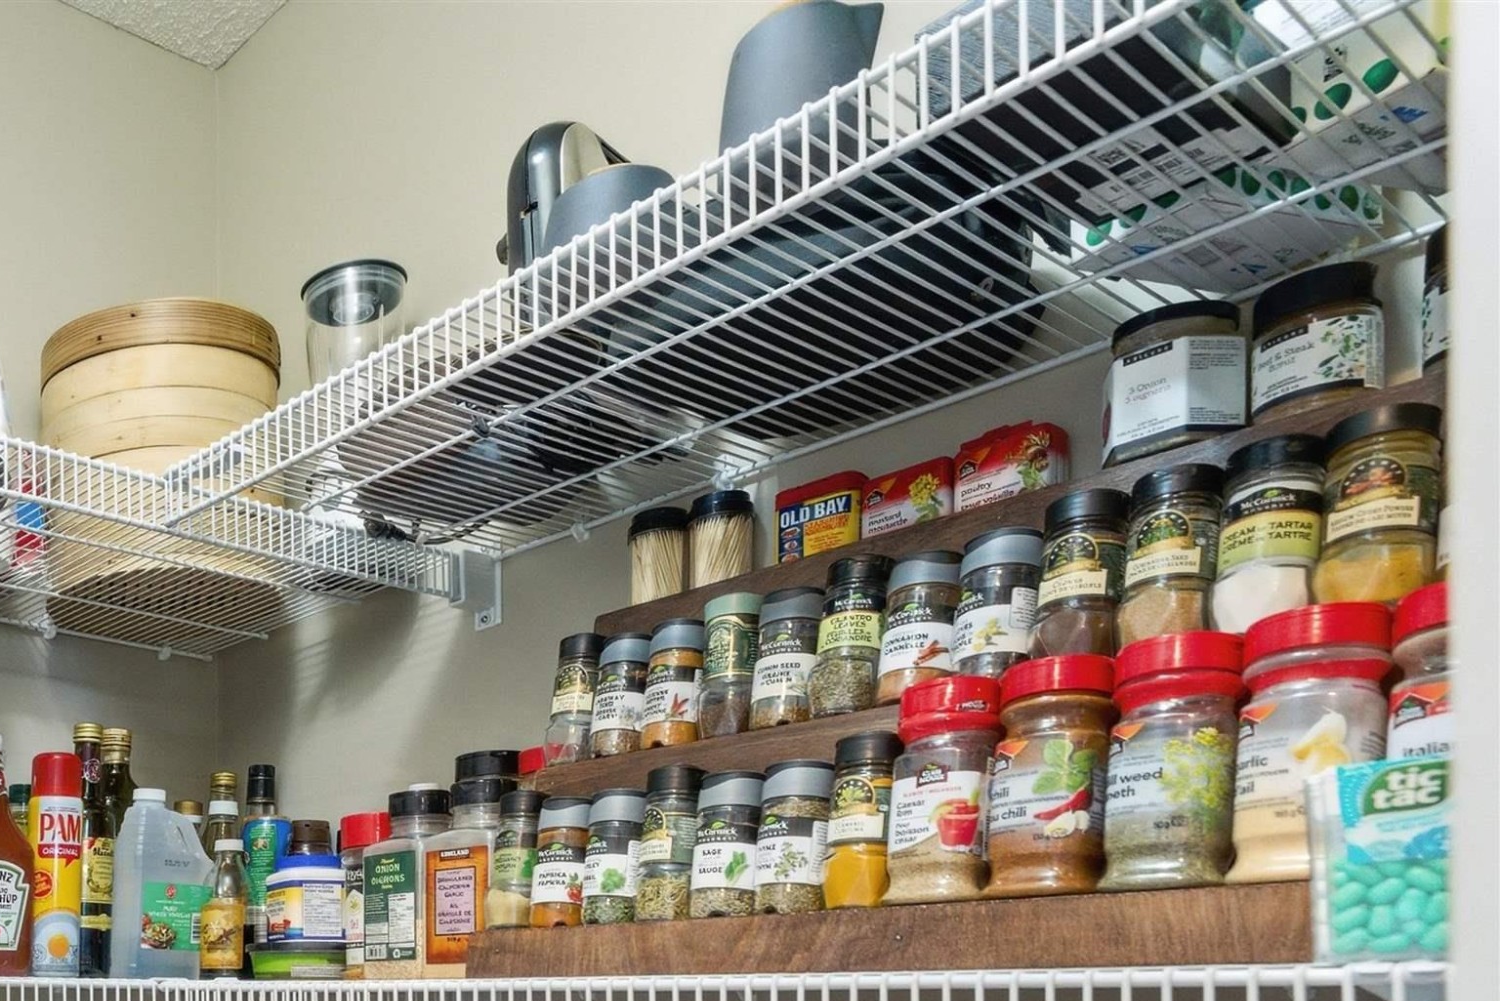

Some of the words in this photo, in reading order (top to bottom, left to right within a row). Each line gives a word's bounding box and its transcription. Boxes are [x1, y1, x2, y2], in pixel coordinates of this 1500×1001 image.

[1239, 493, 1297, 510] McCormick
[780, 505, 812, 529] OLD
[813, 495, 848, 519] BAY
[1267, 520, 1314, 531] TARTAR
[1268, 531, 1313, 541] TARTRE
[830, 614, 873, 626] CILANTRO
[1120, 766, 1164, 784] weed
[1385, 766, 1446, 791] tic
[1371, 785, 1443, 810] tac
[1000, 806, 1028, 821] chili
[39, 813, 82, 845] PAM
[41, 847, 79, 857] ORIGINAL
[375, 863, 401, 874] ONION
